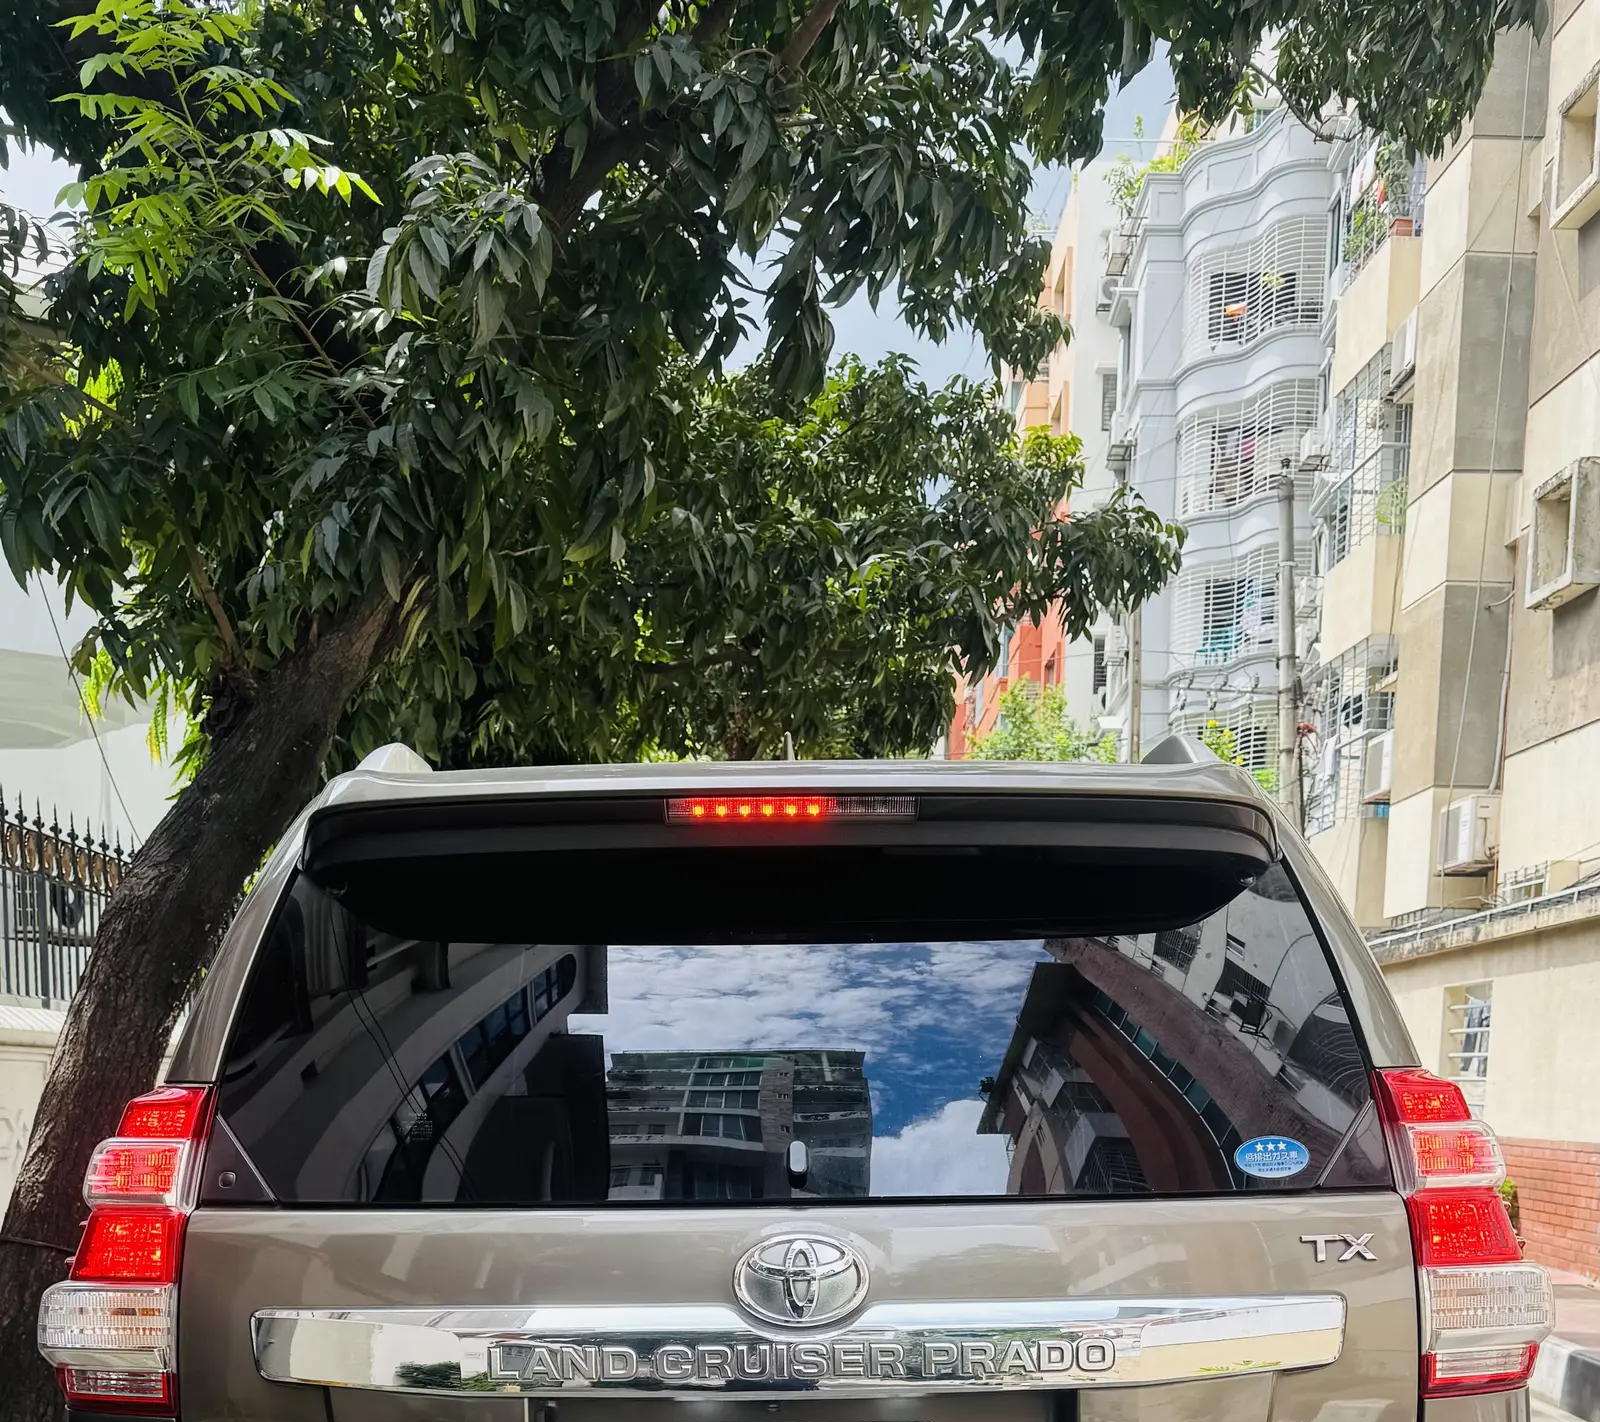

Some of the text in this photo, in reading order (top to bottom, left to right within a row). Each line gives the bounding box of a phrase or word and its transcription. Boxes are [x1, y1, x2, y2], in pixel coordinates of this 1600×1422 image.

[1300, 1232, 1378, 1263] TX
[487, 1337, 1116, 1382] LAND CRUISER PRADO
